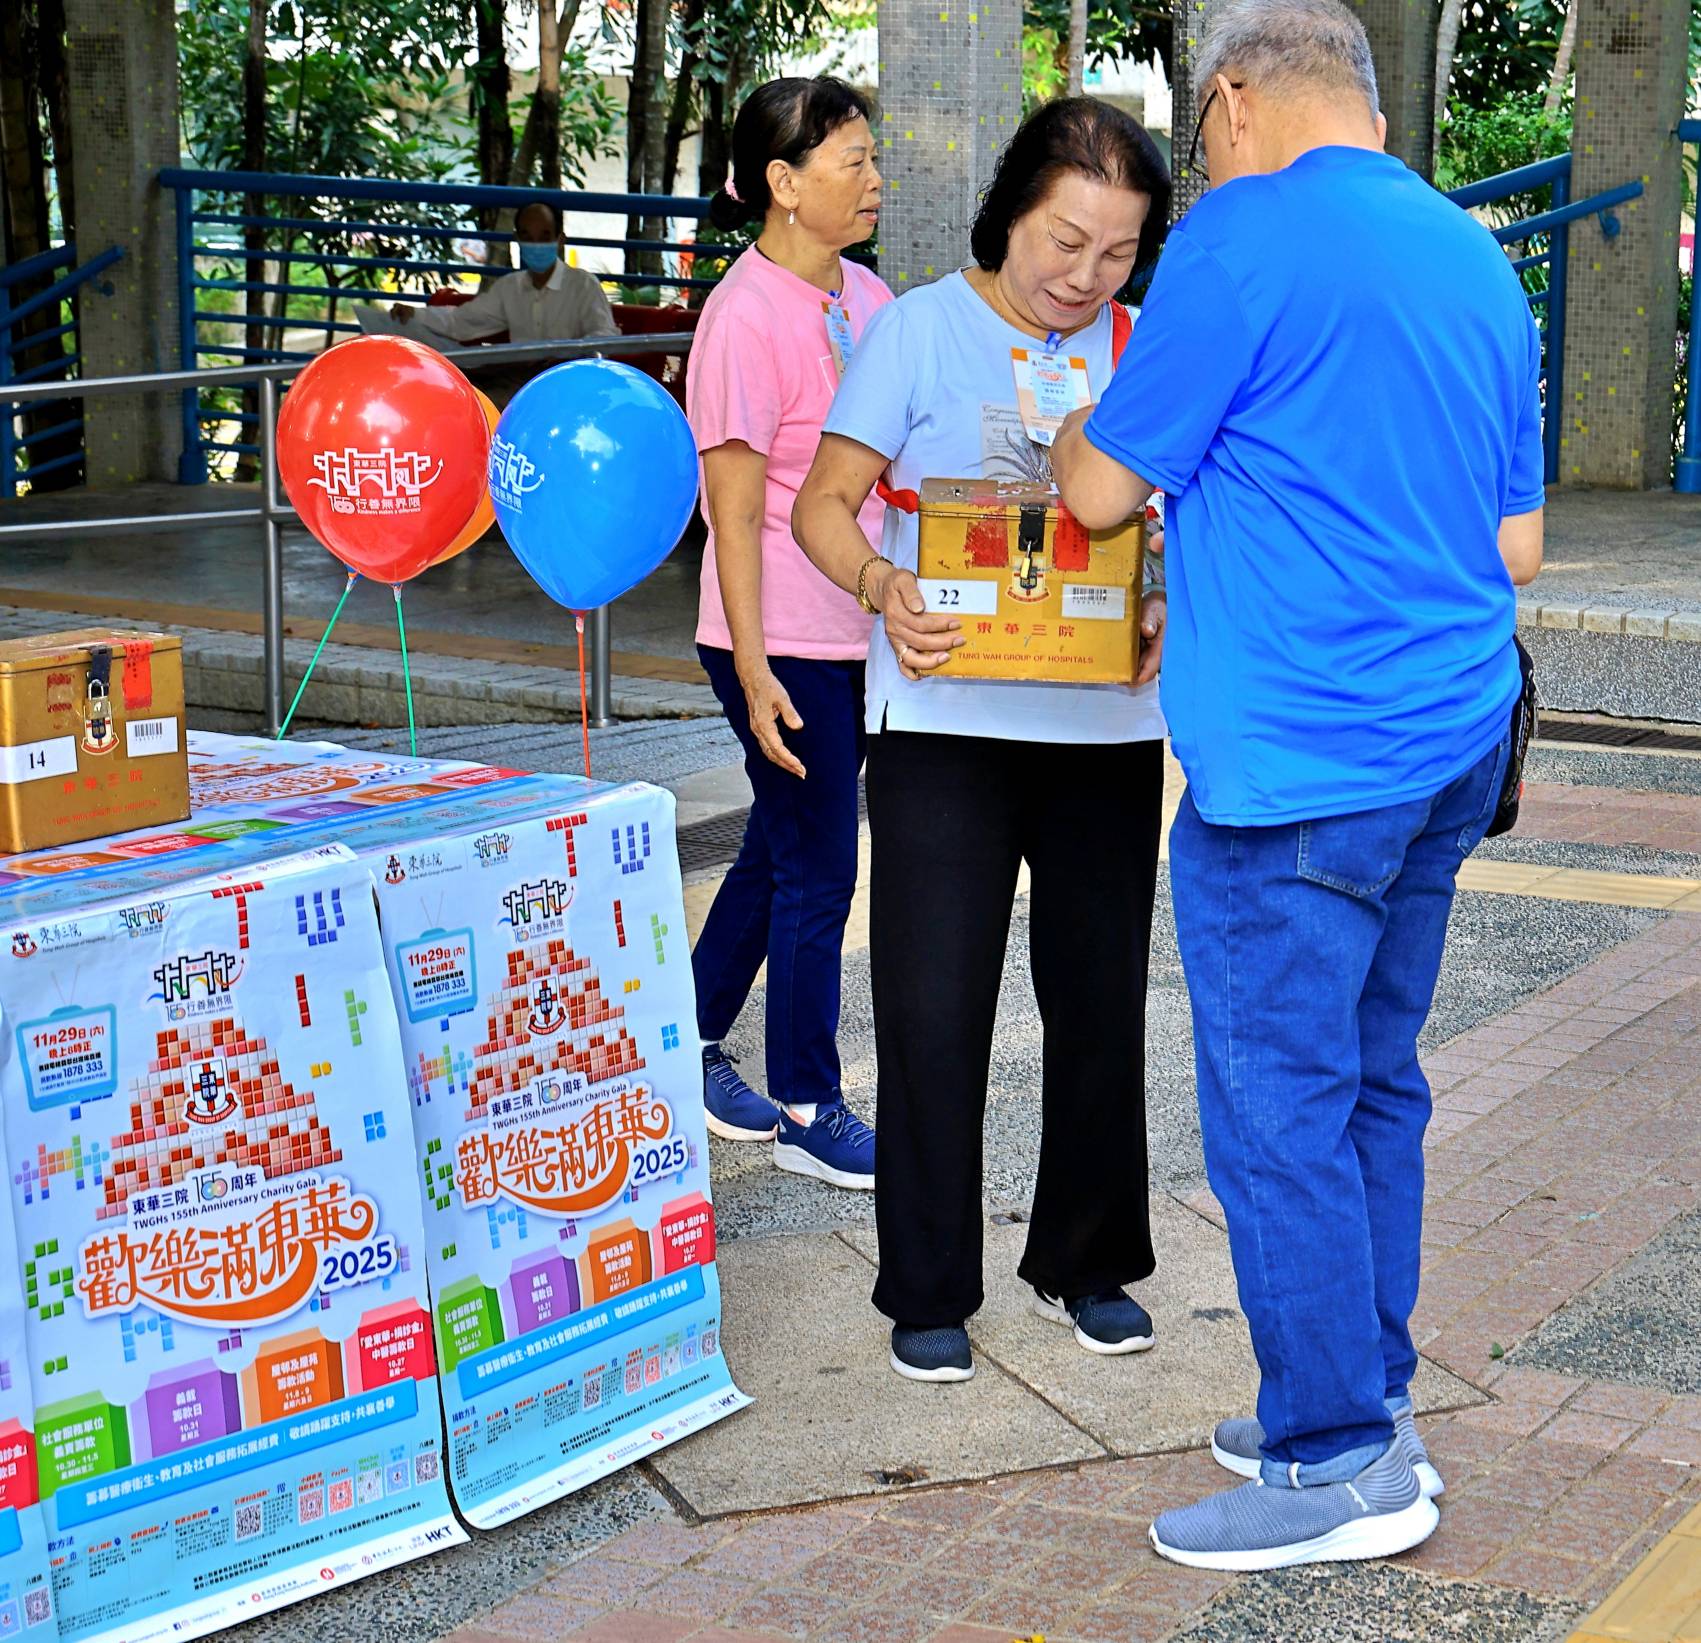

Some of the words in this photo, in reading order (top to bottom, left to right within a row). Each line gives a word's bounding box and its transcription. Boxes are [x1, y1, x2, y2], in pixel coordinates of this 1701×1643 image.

[355, 496, 420, 510] 行善無界限
[938, 588, 960, 605] 22
[976, 621, 1075, 638] 東華三院
[958, 652, 980, 661] TUNG
[983, 653, 1002, 661] WAH
[1003, 655, 1032, 663] GROUP
[1033, 655, 1043, 663] OF
[1048, 655, 1094, 664] HOSPITALS
[28, 750, 47, 770] 14
[314, 845, 342, 857] HKT
[529, 918, 564, 934] 行善無界限
[408, 947, 451, 967] 11月29日
[433, 982, 450, 993] 1878
[452, 978, 466, 989] 333
[187, 994, 232, 1012] 行善無界限
[33, 1026, 86, 1048] 11月29日
[63, 1065, 84, 1078] 1878
[86, 1060, 103, 1072] 333
[493, 1115, 519, 1131] TWGHs
[520, 1110, 541, 1122] 155th
[541, 1096, 584, 1116] Anniversary
[584, 1089, 610, 1103] Charity
[611, 1083, 627, 1095] Gala
[457, 1087, 671, 1203] 歡樂滿東華
[633, 1140, 685, 1180] 2025
[132, 1215, 168, 1231] TWGHs
[171, 1207, 199, 1221] 155th
[200, 1191, 259, 1215] Anniversary
[260, 1182, 295, 1199] Charity
[296, 1177, 317, 1190] Gala
[79, 1182, 375, 1312] 歡樂滿東華
[323, 1240, 393, 1285] 2025
[718, 1393, 739, 1409] HKT
[451, 1406, 477, 1424] 捐款方法
[41, 1416, 104, 1447] 社會服務單位
[179, 1421, 199, 1433] 10.31
[425, 1525, 453, 1544] HKT
